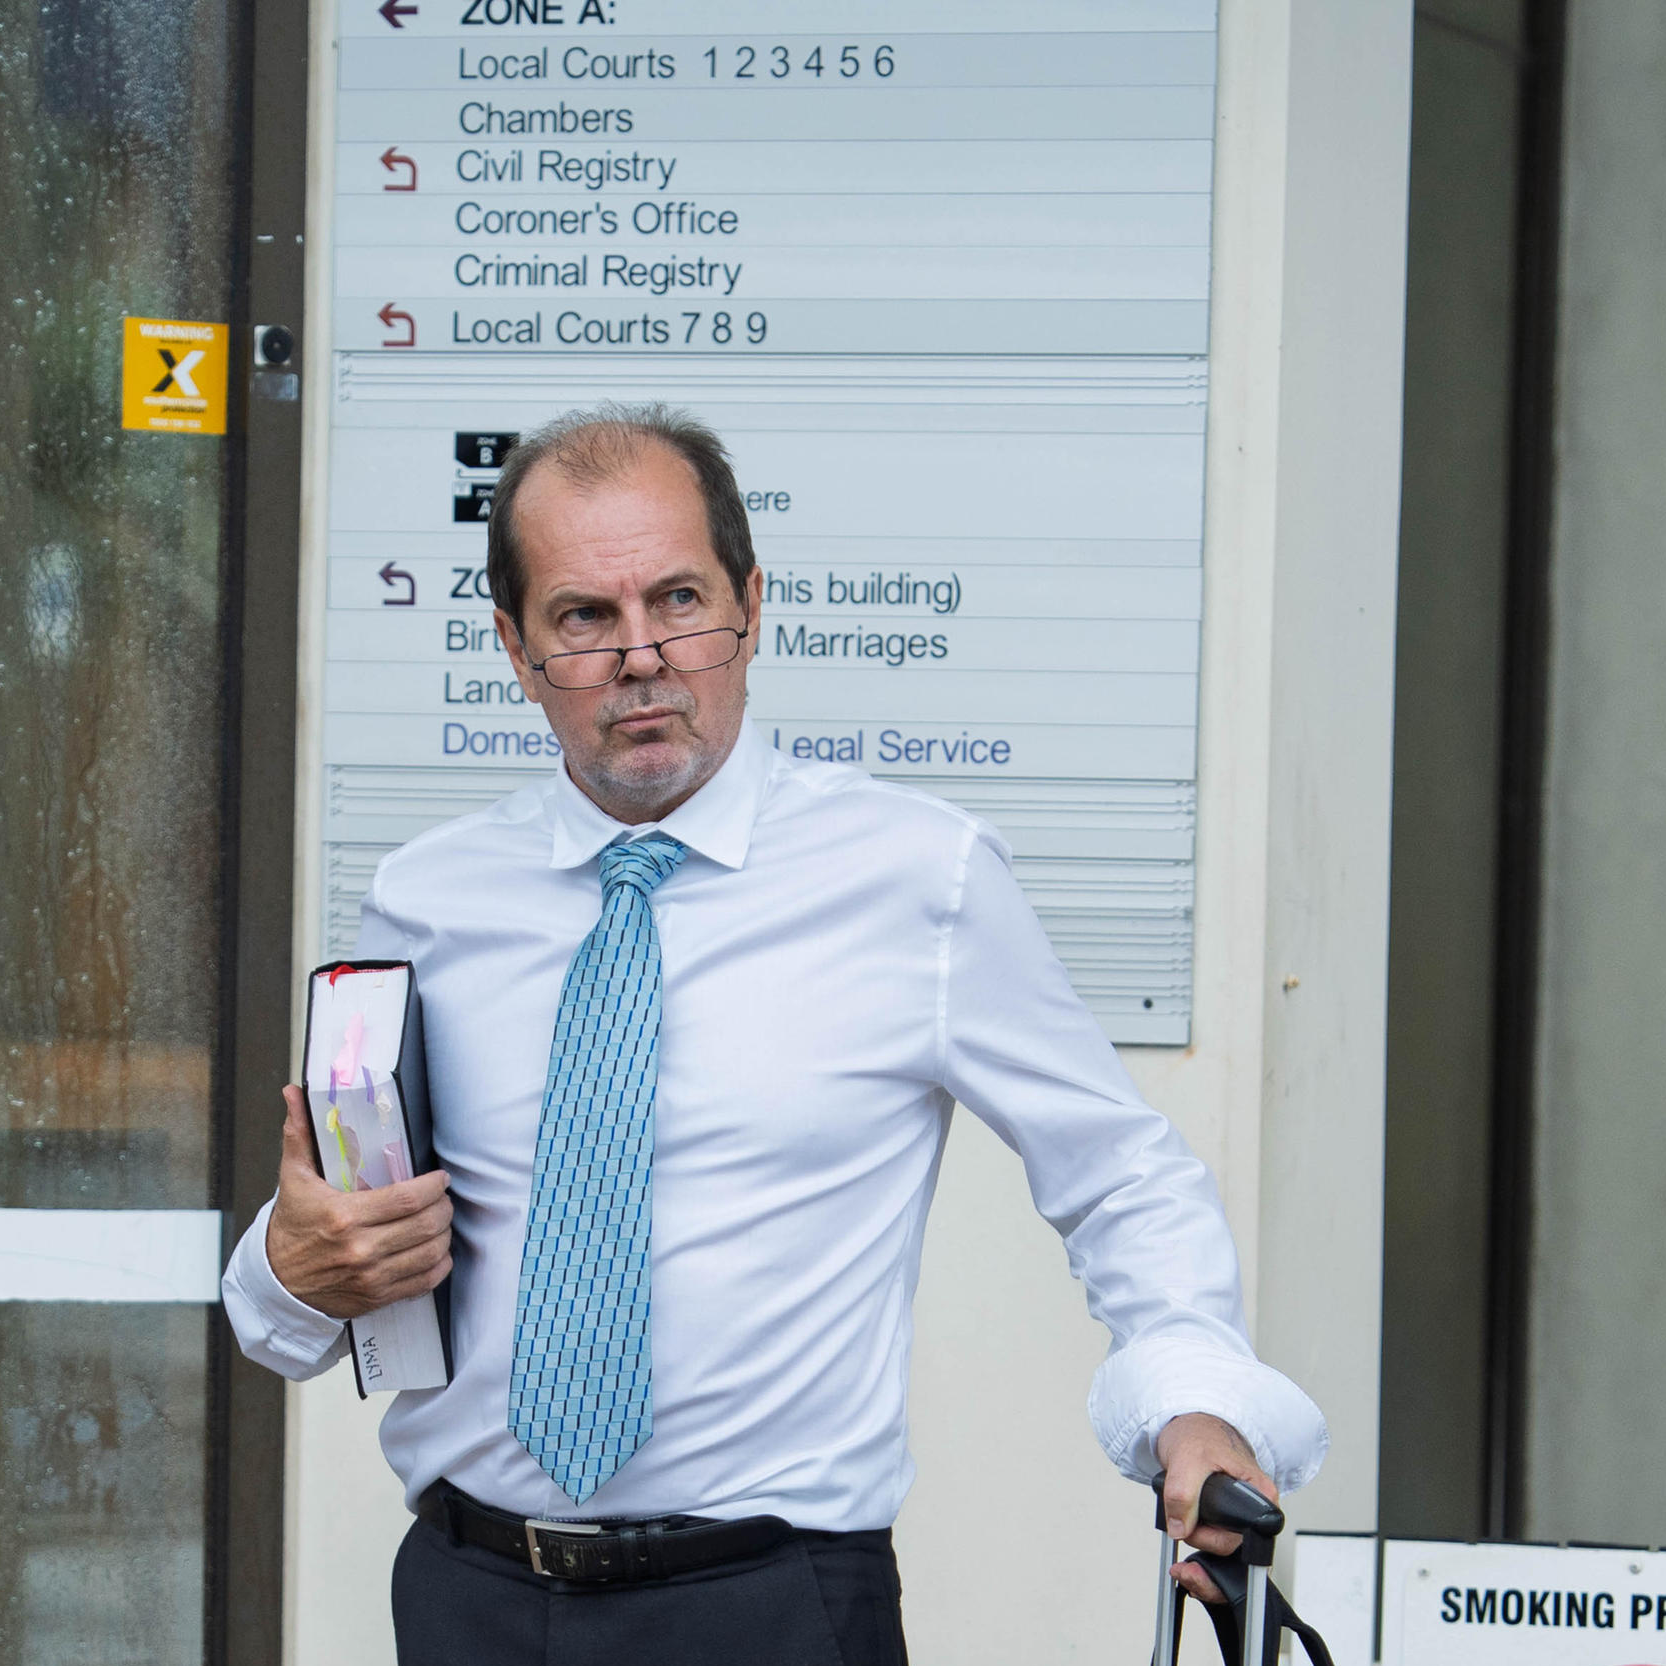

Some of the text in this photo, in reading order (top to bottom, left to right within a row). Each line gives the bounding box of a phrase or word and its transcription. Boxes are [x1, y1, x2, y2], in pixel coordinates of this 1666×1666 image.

[460, 0, 615, 26] ZONE A:
[459, 44, 895, 80] Local Courts 1 2 3 4 5 6
[459, 101, 634, 135] Chambers
[456, 149, 677, 191] Civil Registry
[455, 201, 739, 235] Coroner's Office
[454, 253, 742, 296] Criminal Registry
[452, 311, 767, 345] Local Courts 7 8 9
[479, 446, 494, 464] B
[738, 489, 791, 513] ere
[827, 572, 962, 615] building)
[775, 624, 948, 667] Marriages
[773, 728, 1011, 765] Legal Service
[1441, 1587, 1614, 1629] SMOKING
